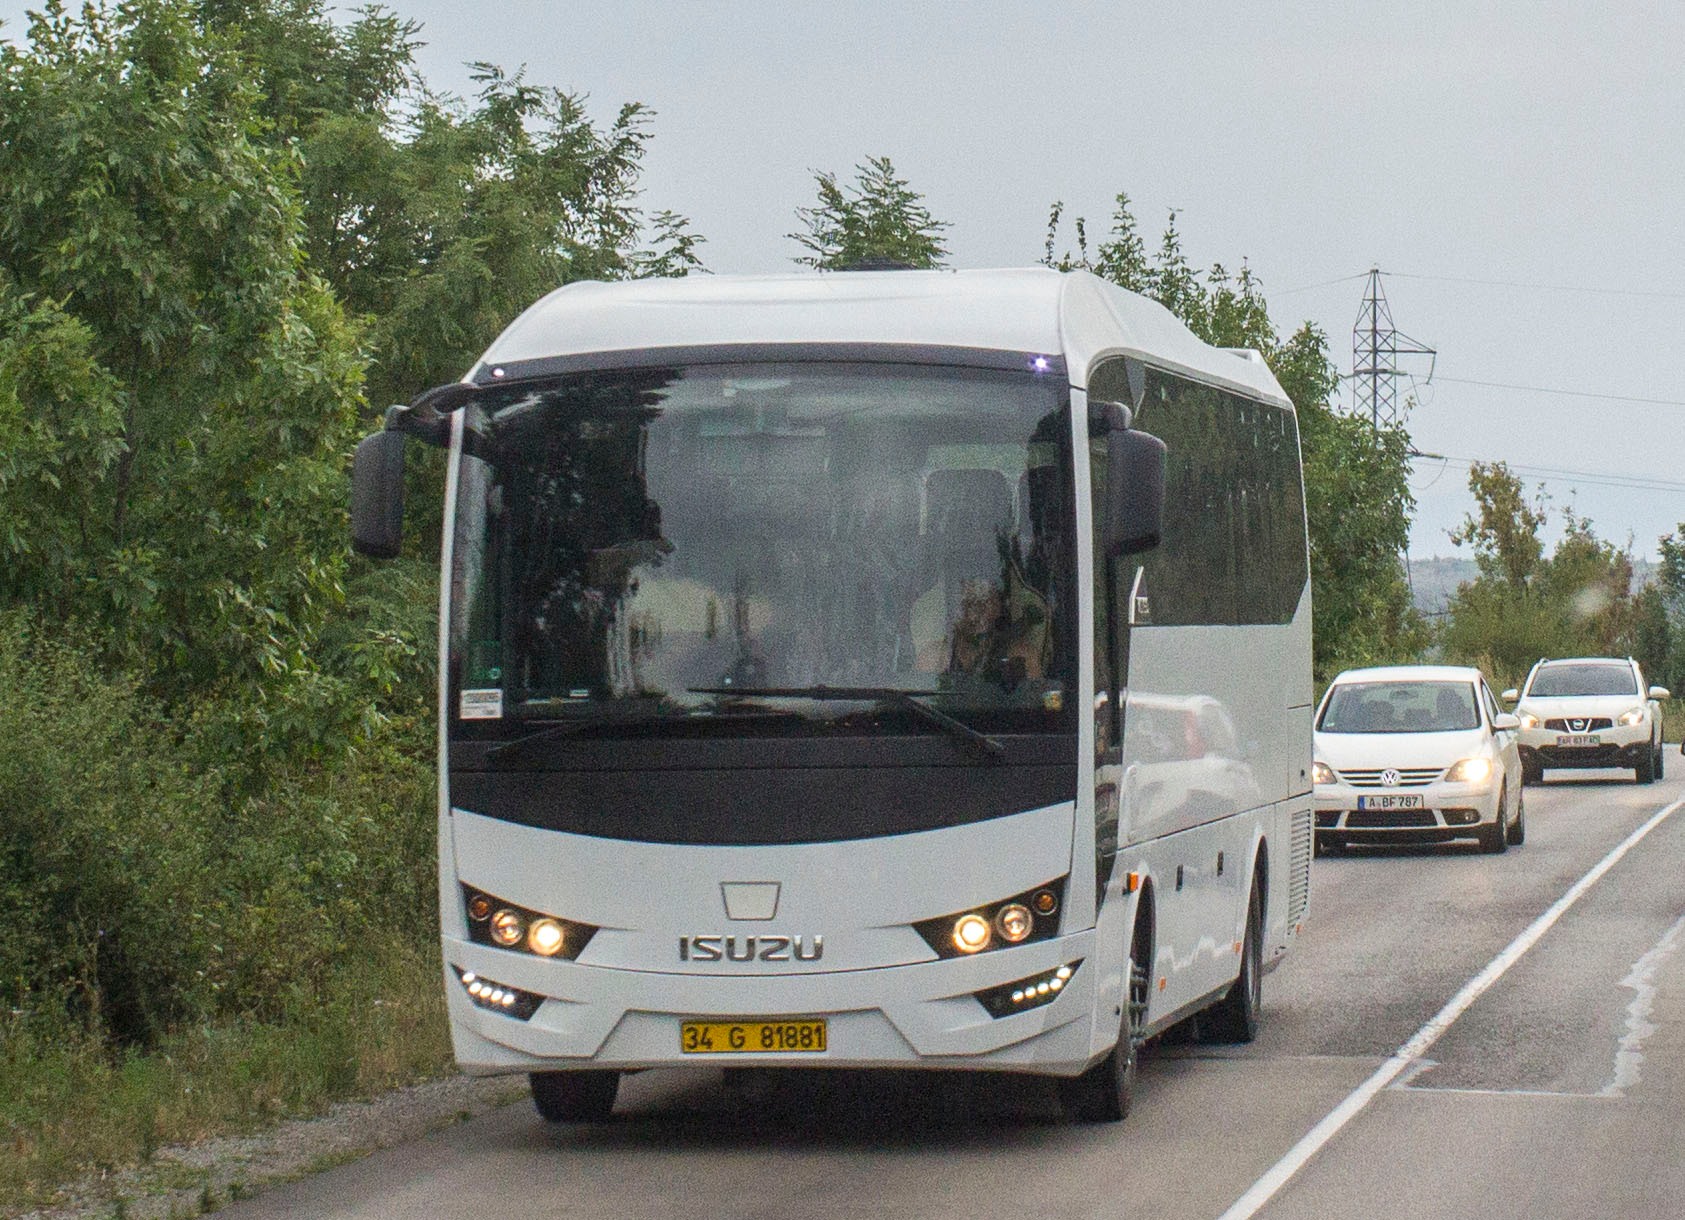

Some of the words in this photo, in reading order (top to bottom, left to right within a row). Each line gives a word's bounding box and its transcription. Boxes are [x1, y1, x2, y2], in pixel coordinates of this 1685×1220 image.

[1369, 798, 1376, 807] A
[679, 935, 823, 961] ISUZU
[685, 1027, 713, 1050] 34
[728, 1027, 745, 1049] G
[760, 1026, 823, 1049] 81881
